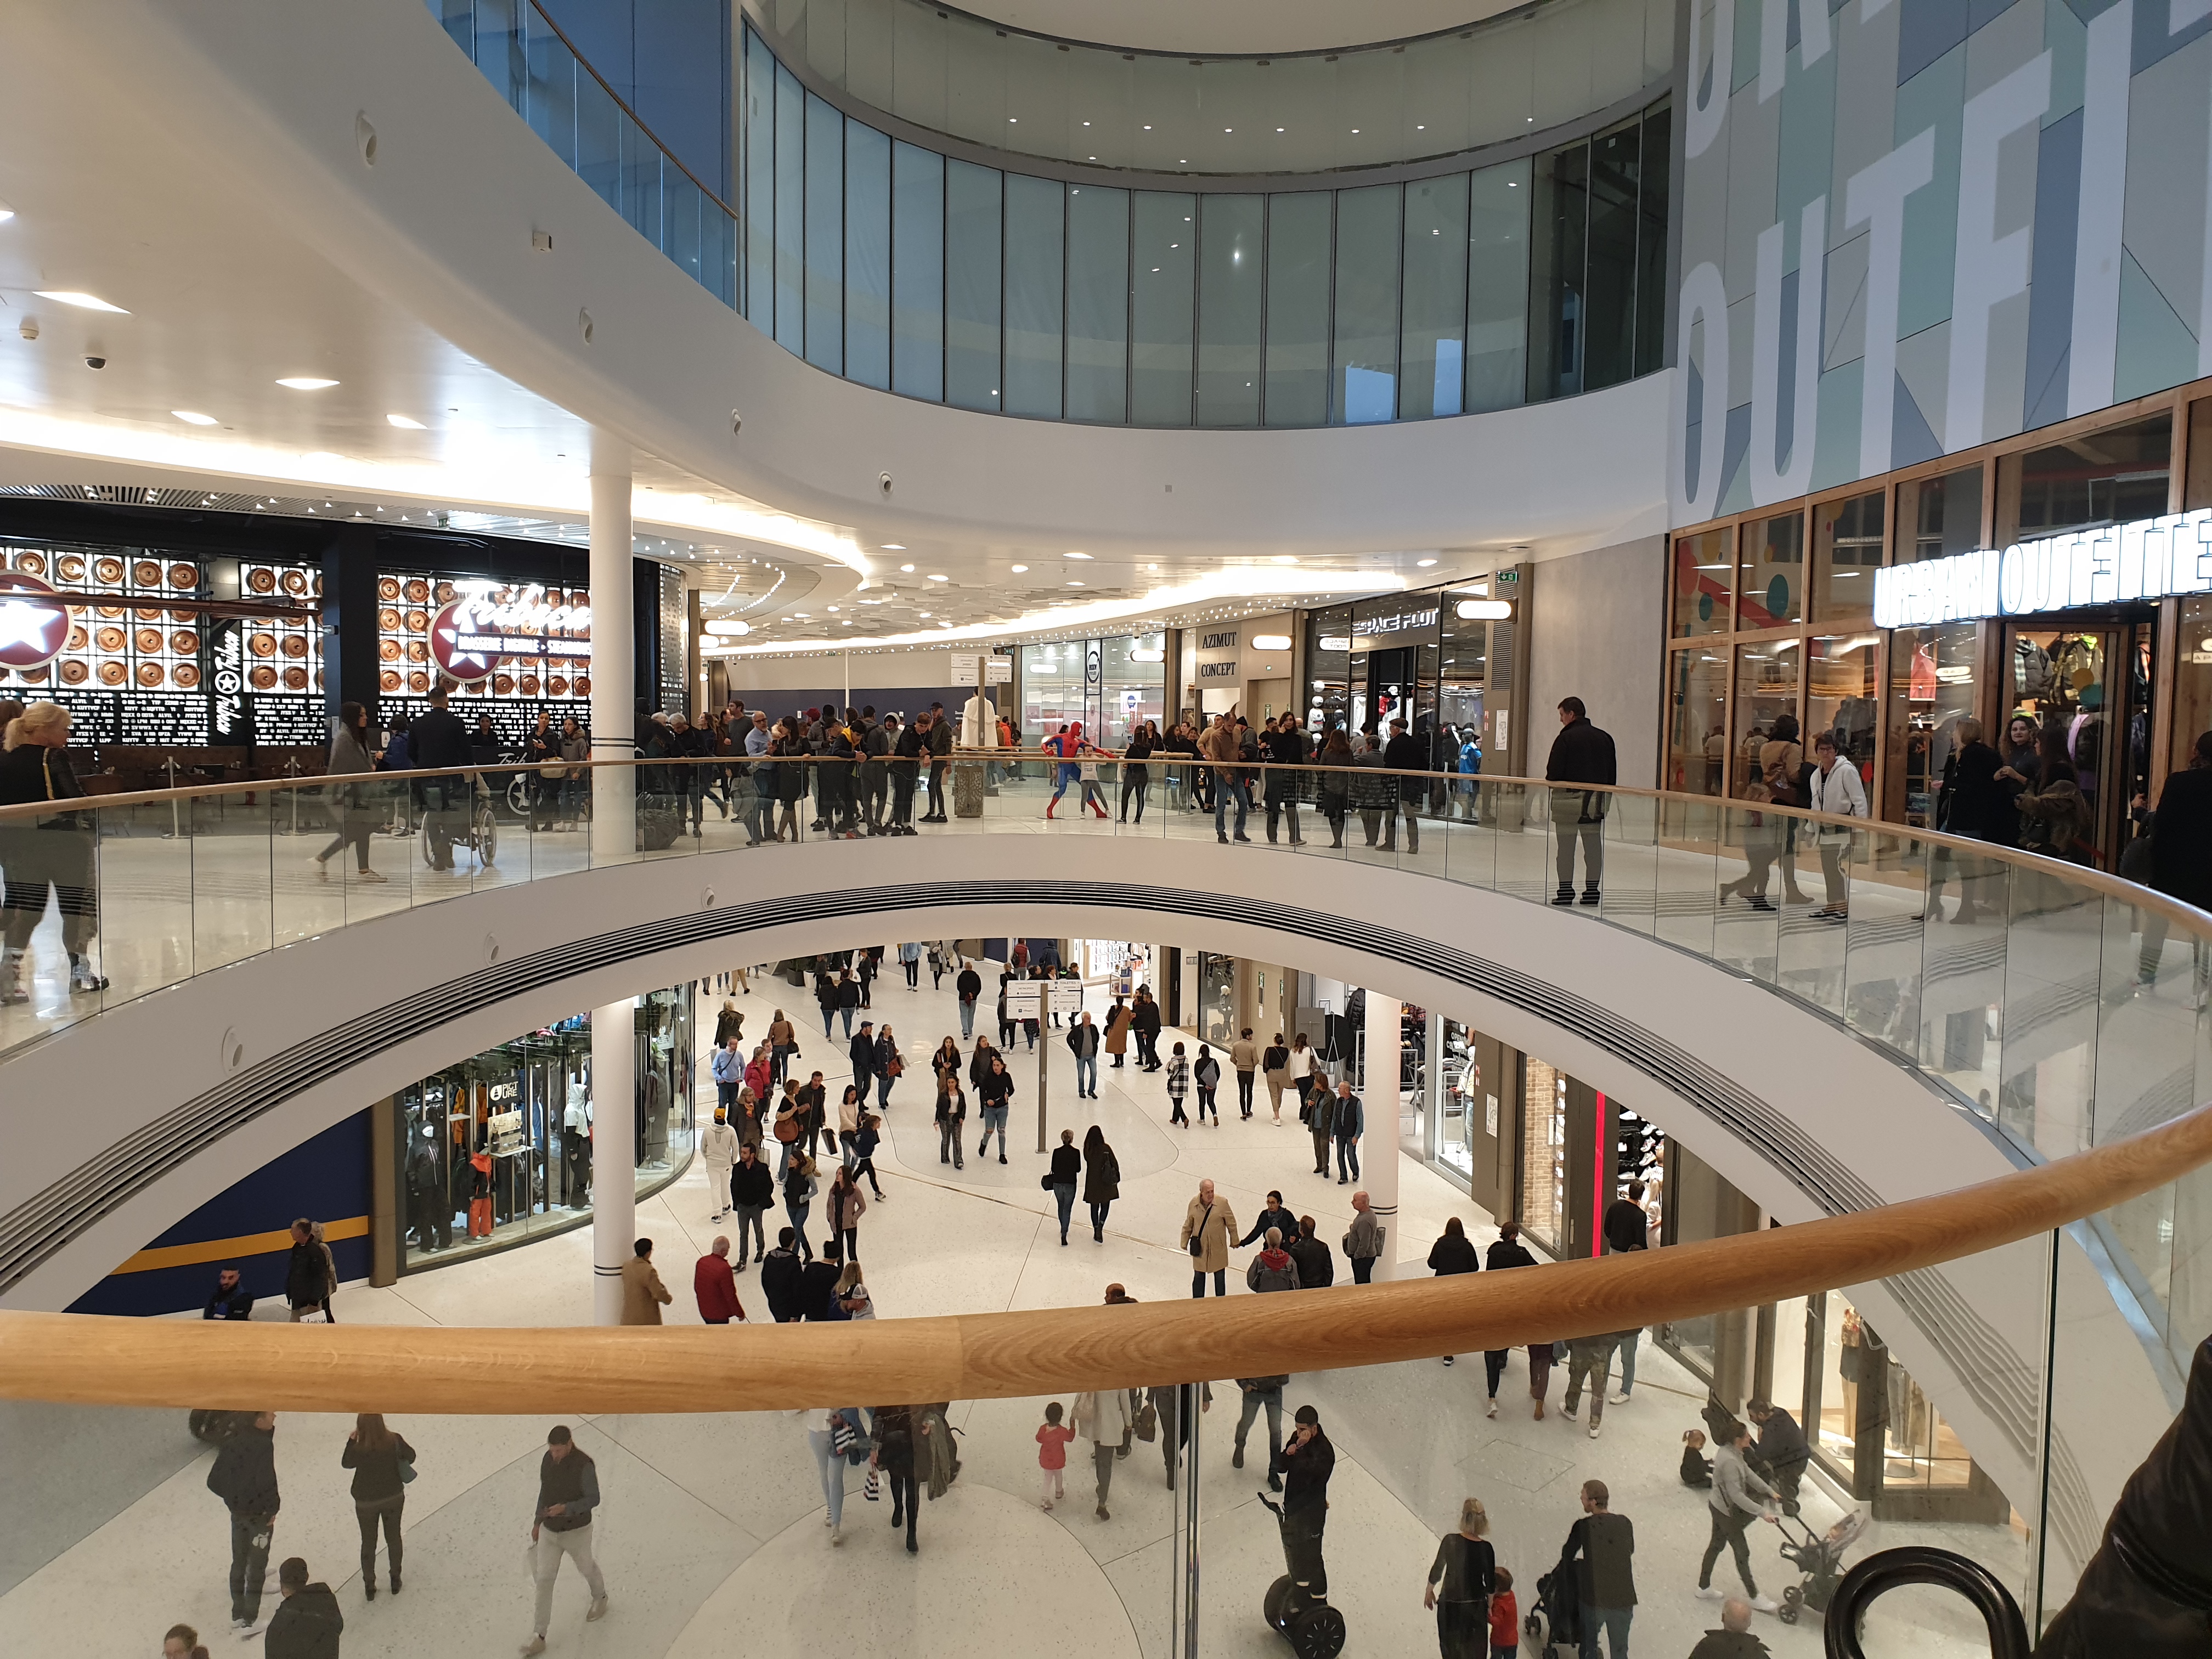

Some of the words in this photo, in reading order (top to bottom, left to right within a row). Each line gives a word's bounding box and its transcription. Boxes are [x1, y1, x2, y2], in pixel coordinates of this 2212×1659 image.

[1671, 0, 2212, 530] OUTFI
[1874, 550, 2001, 629] URBAN
[2001, 507, 2212, 617] OUTFITTE
[1202, 631, 1237, 648] AZIMUT
[214, 629, 240, 671] Tribeca
[1201, 662, 1235, 677] CONCEPT
[498, 752, 527, 764] Trib
[502, 1081, 518, 1091] PICT
[502, 1091, 517, 1099] URE
